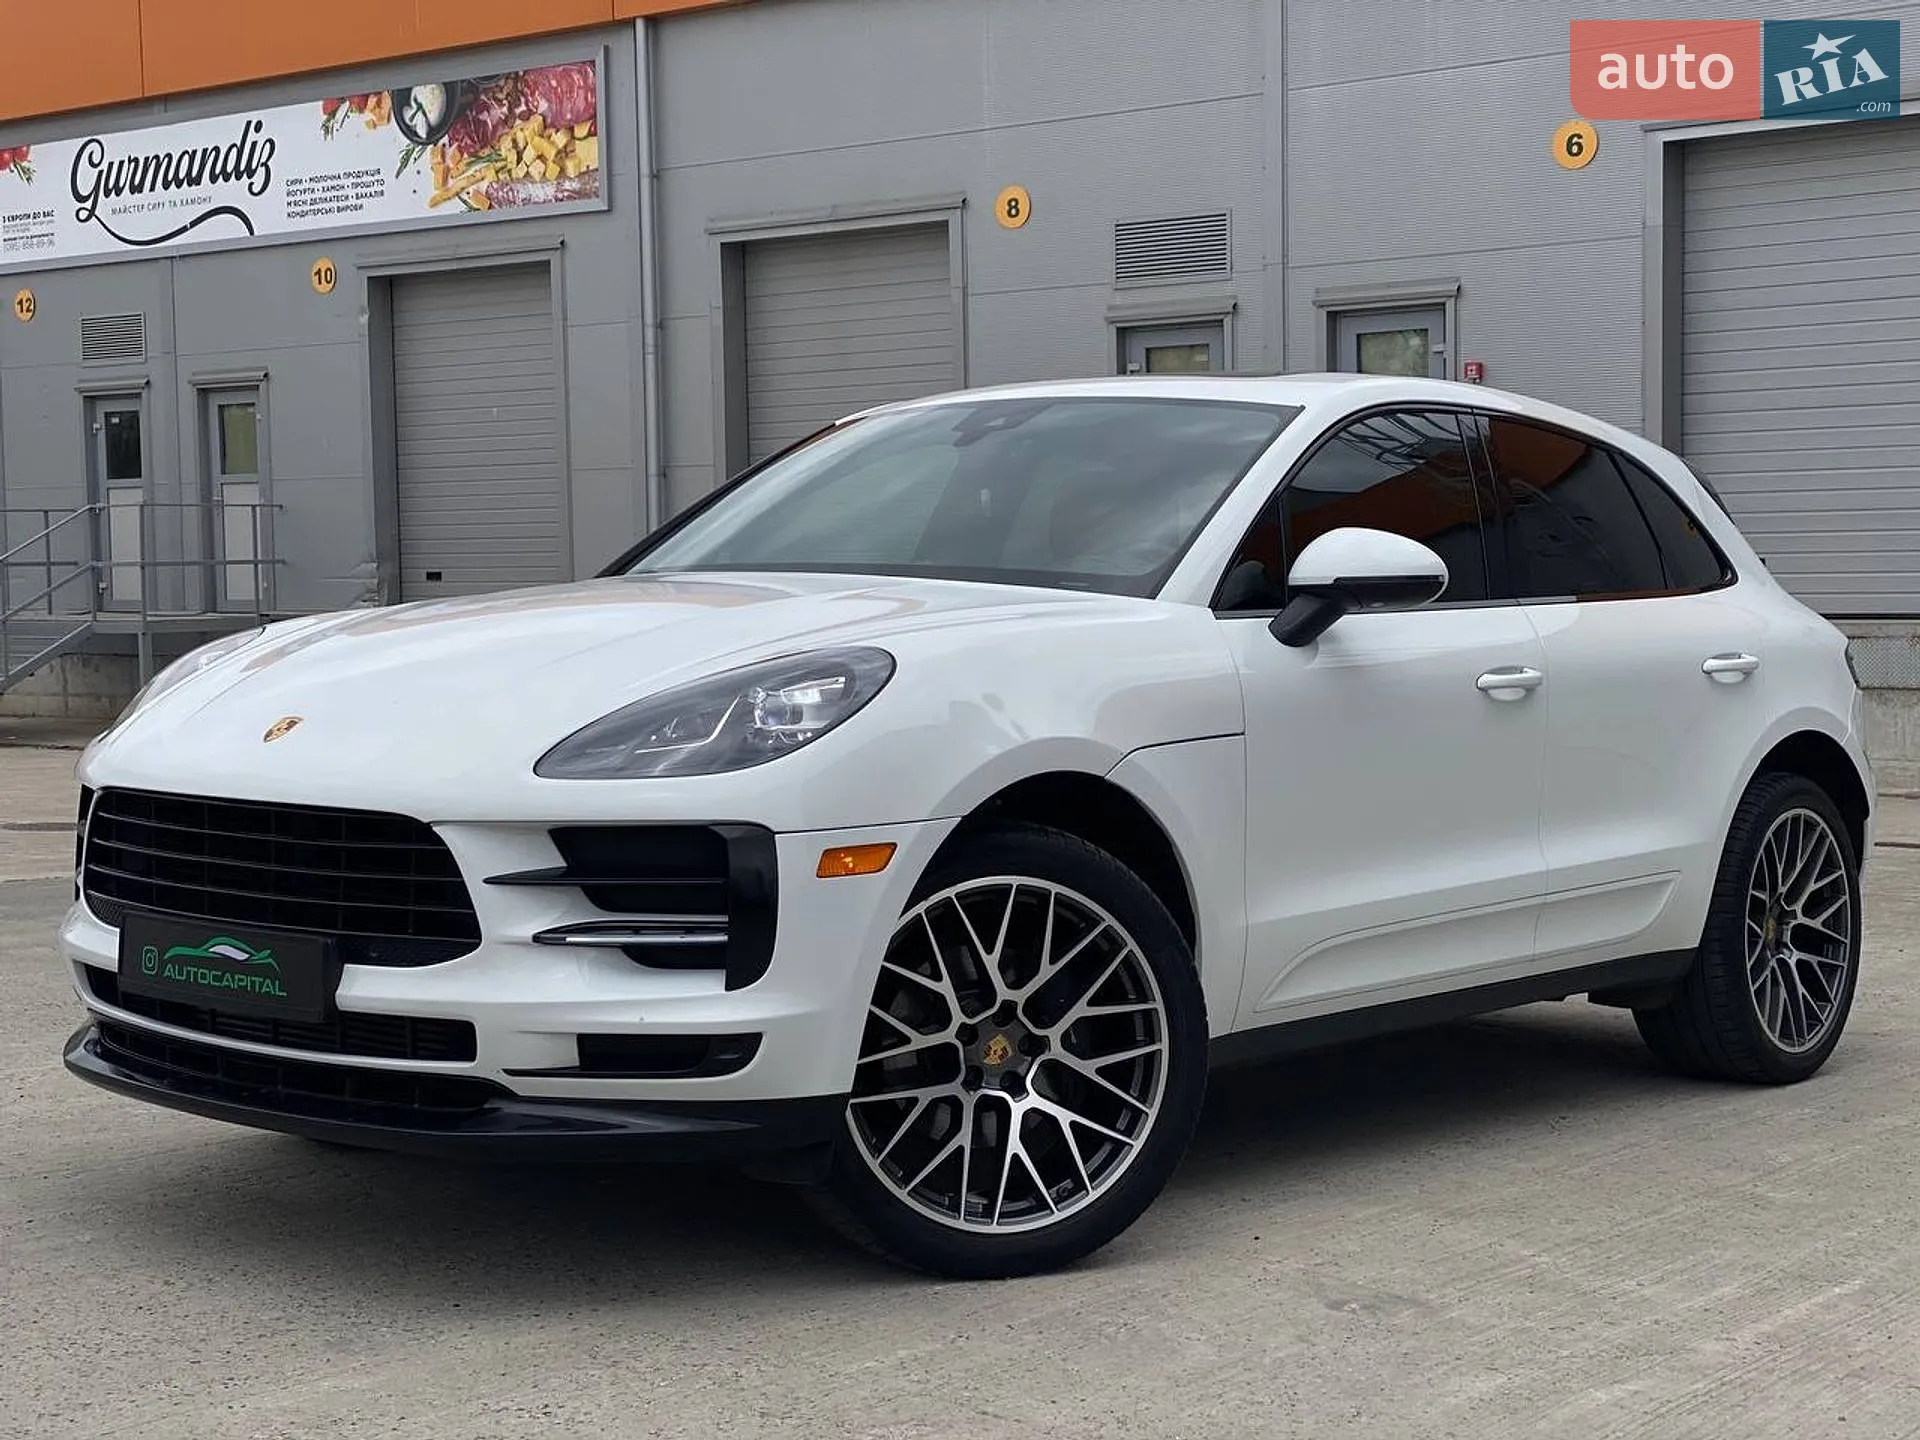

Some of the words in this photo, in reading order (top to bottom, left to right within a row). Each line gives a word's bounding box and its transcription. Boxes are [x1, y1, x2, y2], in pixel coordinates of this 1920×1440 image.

[1565, 133, 1584, 157] 6
[71, 120, 276, 223] Gurmandiz
[308, 172, 342, 184] МОЛОЧНА
[321, 183, 346, 193] ХАМОН
[351, 178, 385, 190] ПРОШУТО
[111, 203, 145, 216] МАЙСТЕР
[1006, 197, 1020, 219] 8
[313, 267, 333, 286] 10
[16, 298, 33, 313] 12
[163, 963, 288, 997] AUTOCAPITAL
